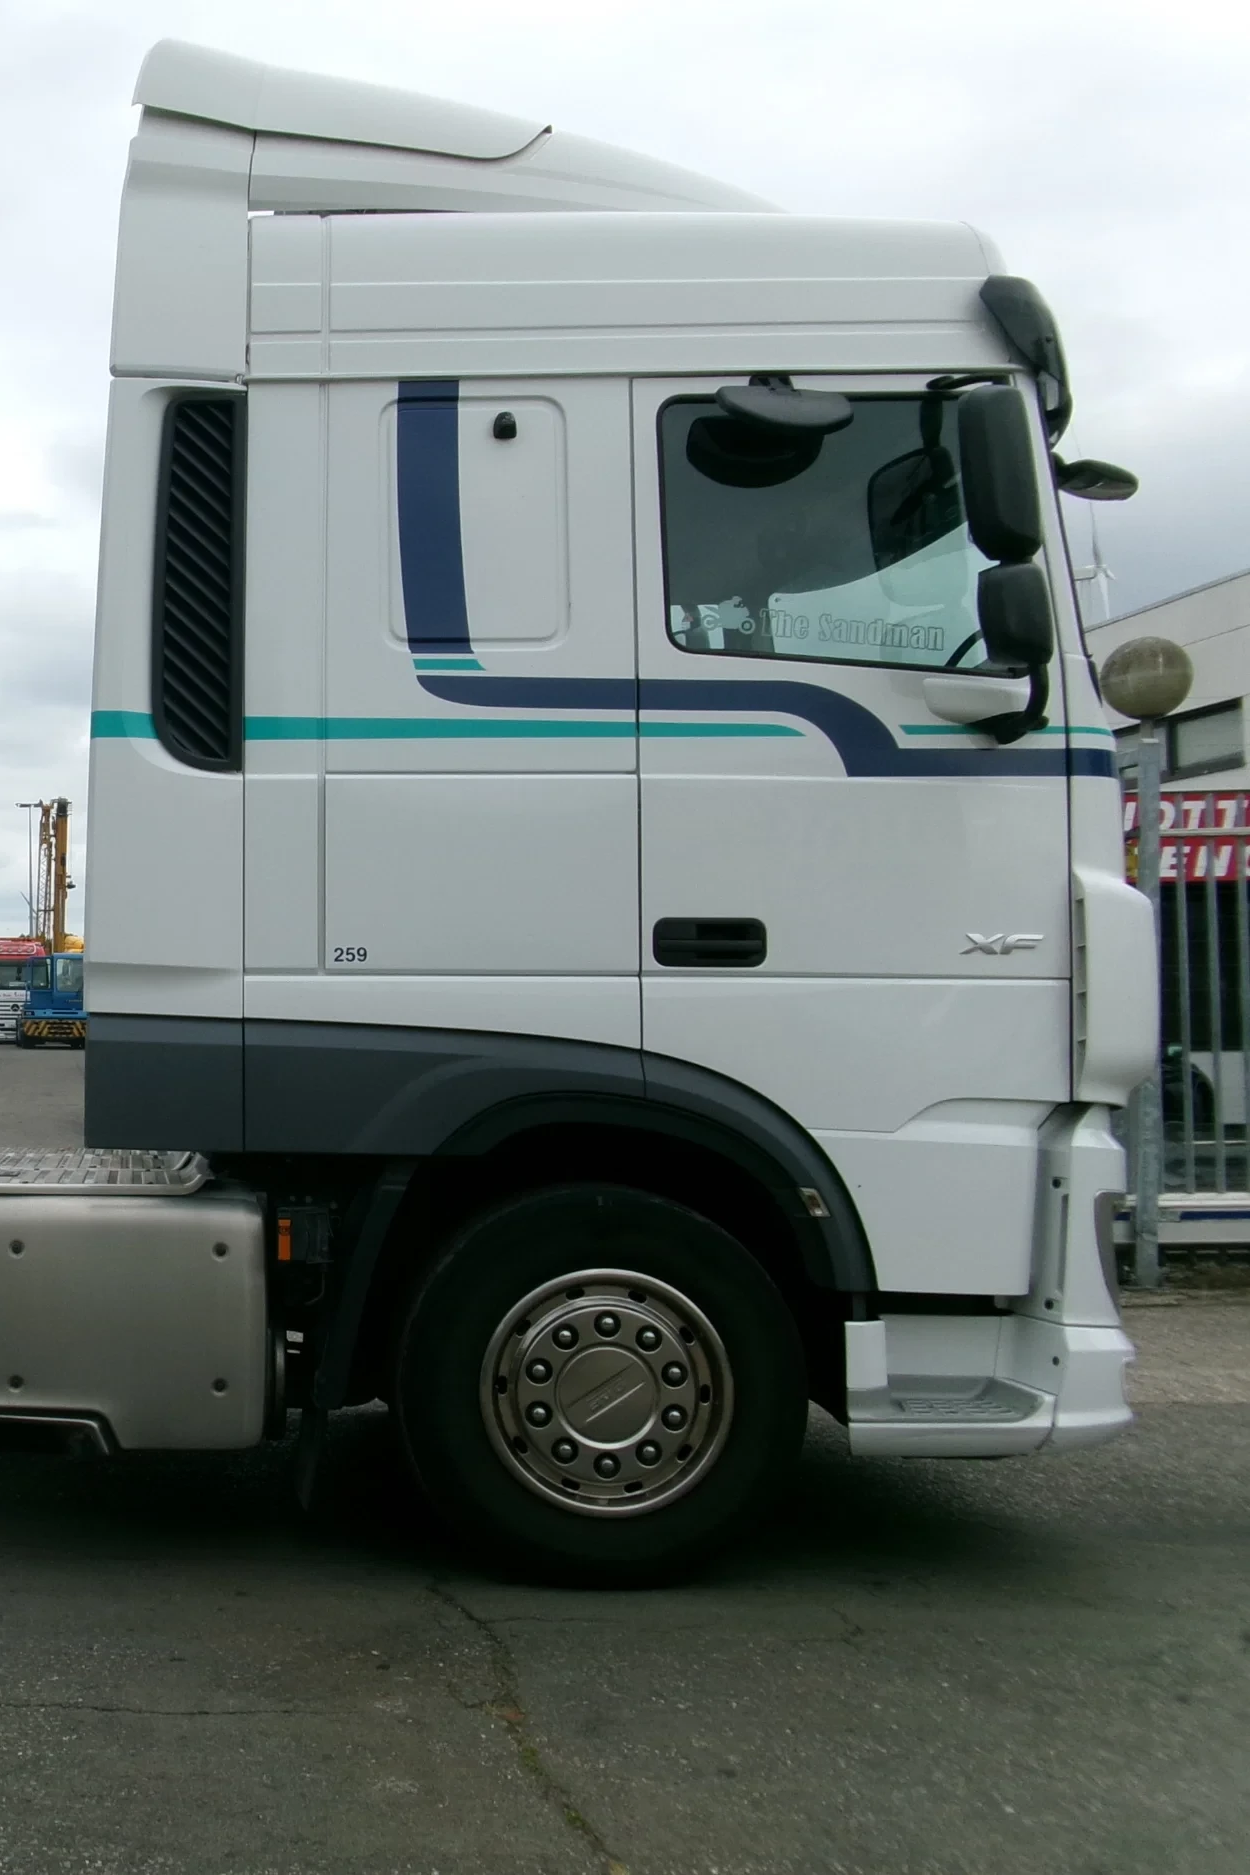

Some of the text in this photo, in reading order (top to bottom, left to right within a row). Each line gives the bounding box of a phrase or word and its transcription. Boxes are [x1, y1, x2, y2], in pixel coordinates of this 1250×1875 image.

[759, 608, 945, 651] The Sandman
[333, 946, 368, 962] 259
[959, 933, 1045, 955] XF
